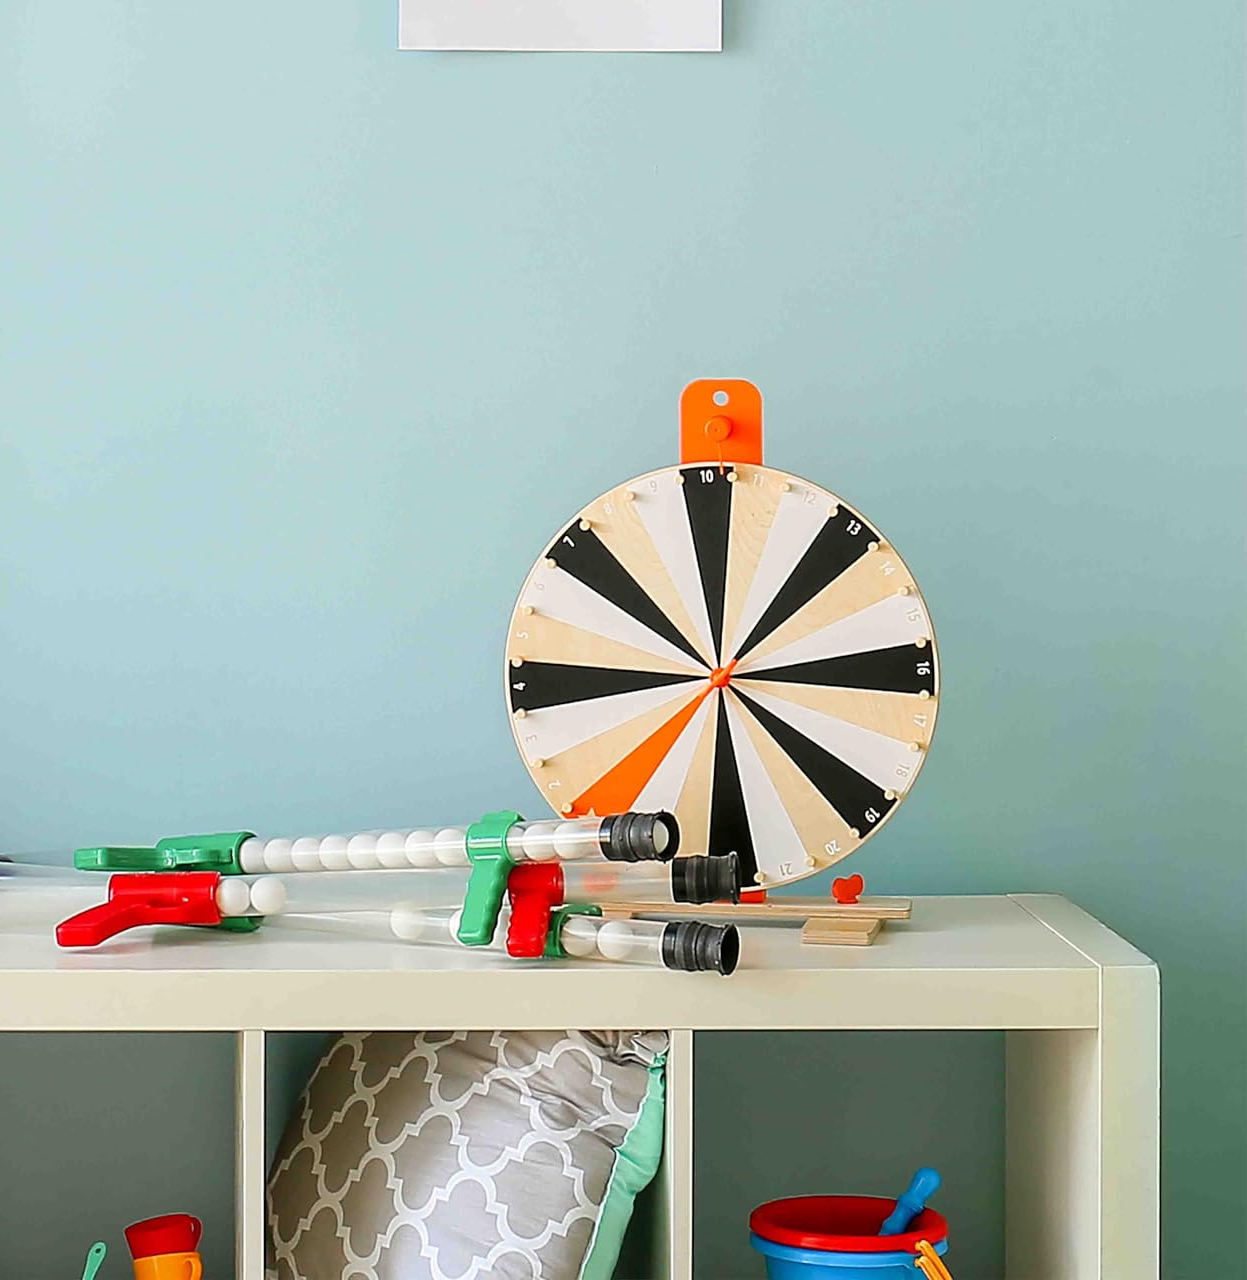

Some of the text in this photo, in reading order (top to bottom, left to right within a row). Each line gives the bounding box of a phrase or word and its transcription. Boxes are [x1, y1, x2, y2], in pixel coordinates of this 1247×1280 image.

[699, 469, 714, 484] 10
[802, 490, 816, 505] 12
[846, 520, 862, 536] 13
[563, 536, 575, 547] 7
[881, 561, 896, 576] 14
[907, 608, 922, 623] 15
[916, 661, 931, 676] 16
[513, 682, 526, 691] 4
[914, 714, 928, 728] 17
[896, 764, 909, 777] 18
[865, 807, 881, 823] 19
[825, 840, 841, 855] 20
[780, 863, 793, 876] 21
